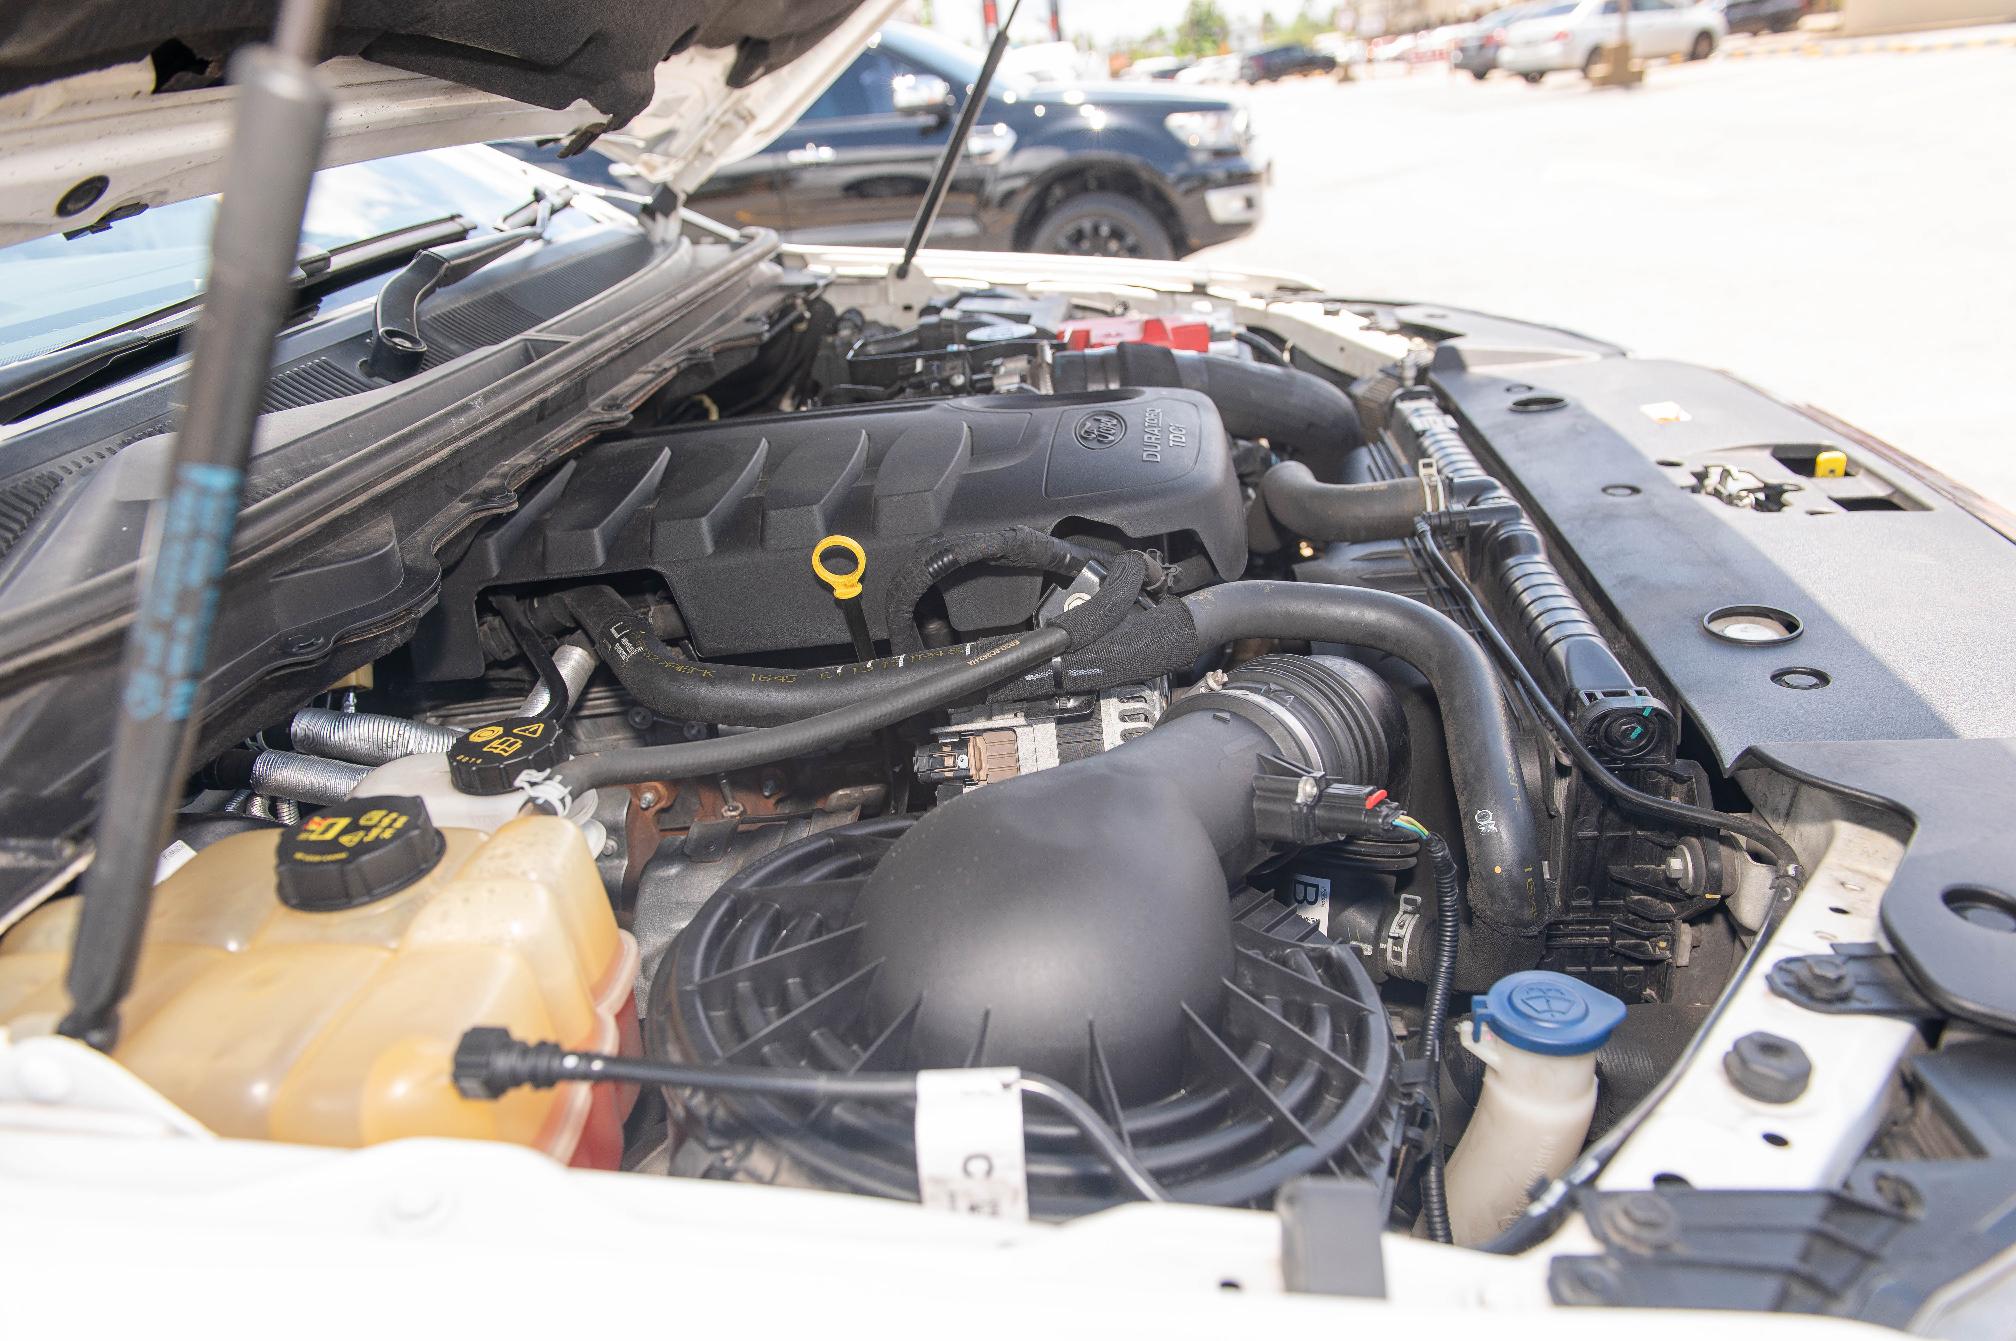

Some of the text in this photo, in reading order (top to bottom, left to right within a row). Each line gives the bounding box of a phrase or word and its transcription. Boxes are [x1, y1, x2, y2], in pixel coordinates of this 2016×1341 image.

[1078, 413, 1122, 446] Ford
[1142, 407, 1163, 463] DURATORQ
[1295, 880, 1320, 905] B
[963, 1153, 993, 1178] C
